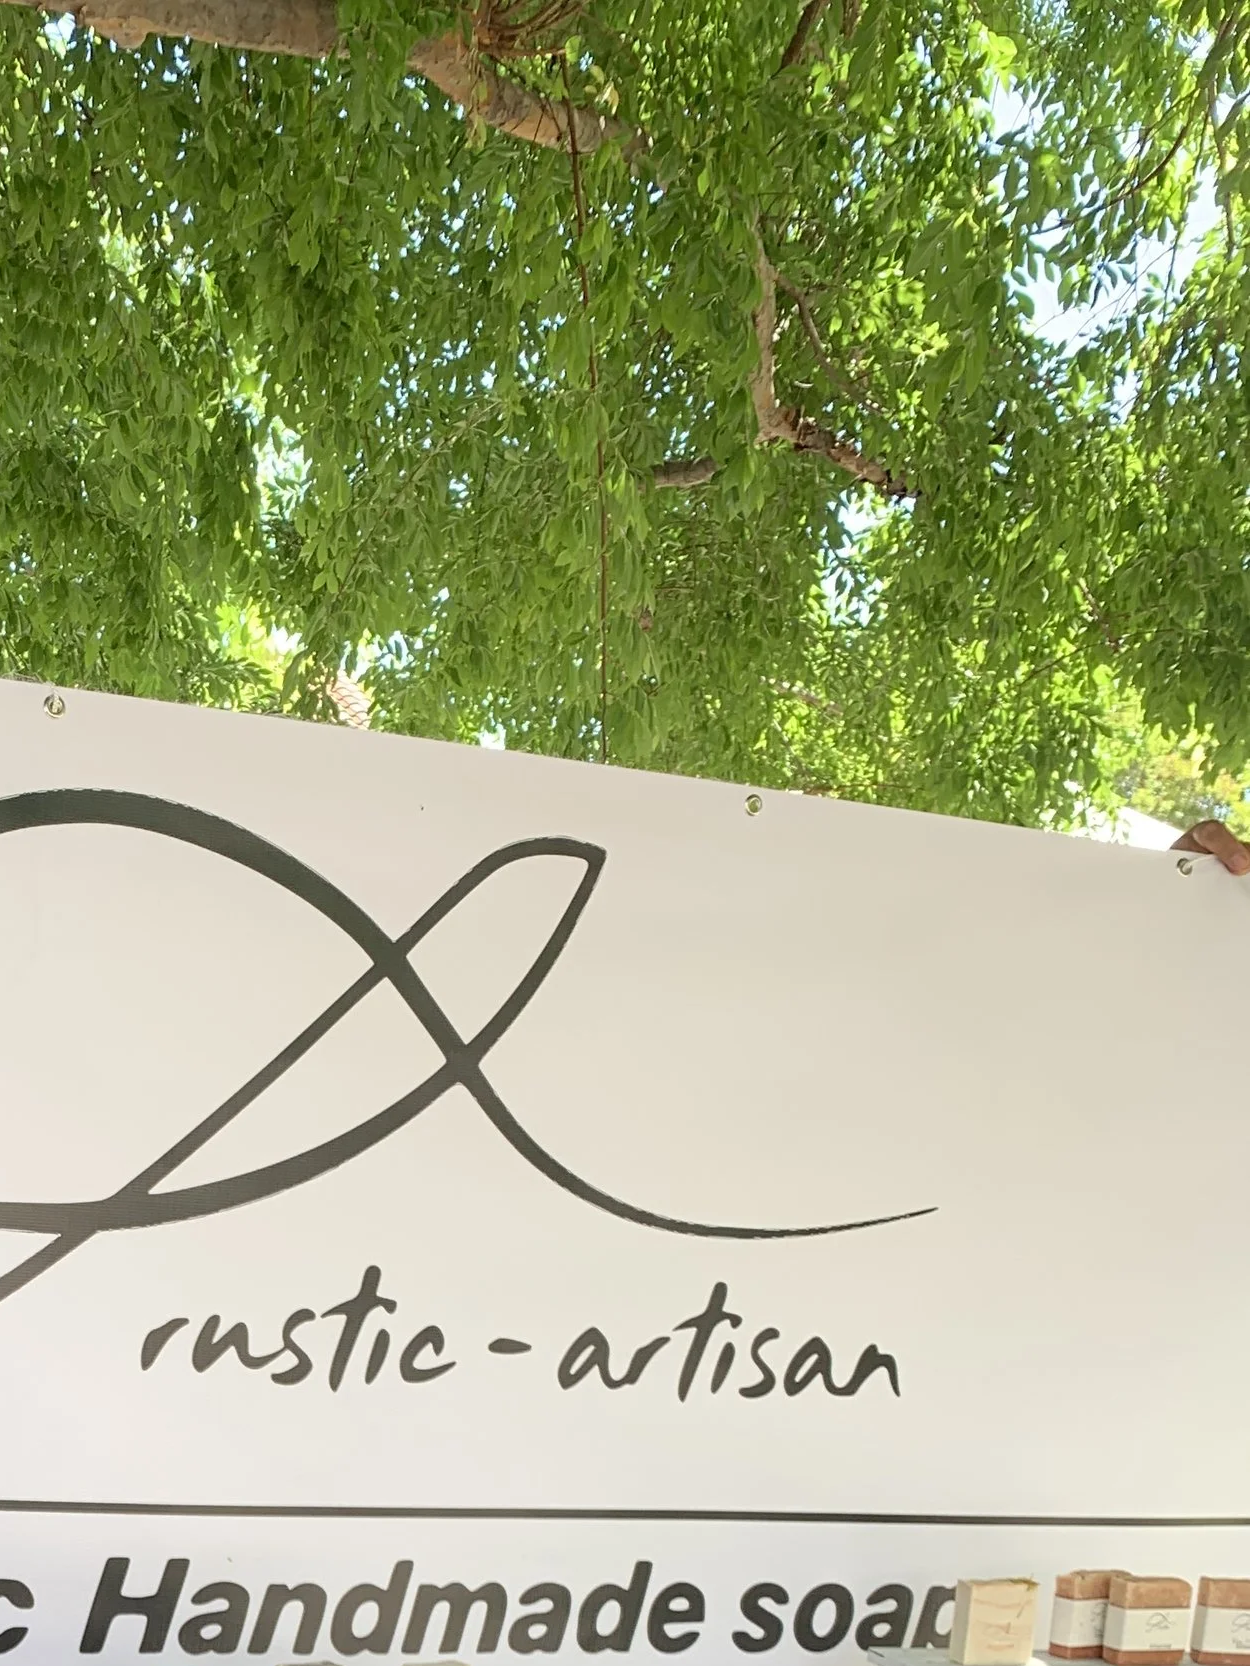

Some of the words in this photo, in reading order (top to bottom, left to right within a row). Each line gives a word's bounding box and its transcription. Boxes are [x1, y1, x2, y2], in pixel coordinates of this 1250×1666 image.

[141, 1265, 456, 1392] rustic
[557, 1281, 900, 1402] artisan
[79, 1557, 706, 1656] Handmade
